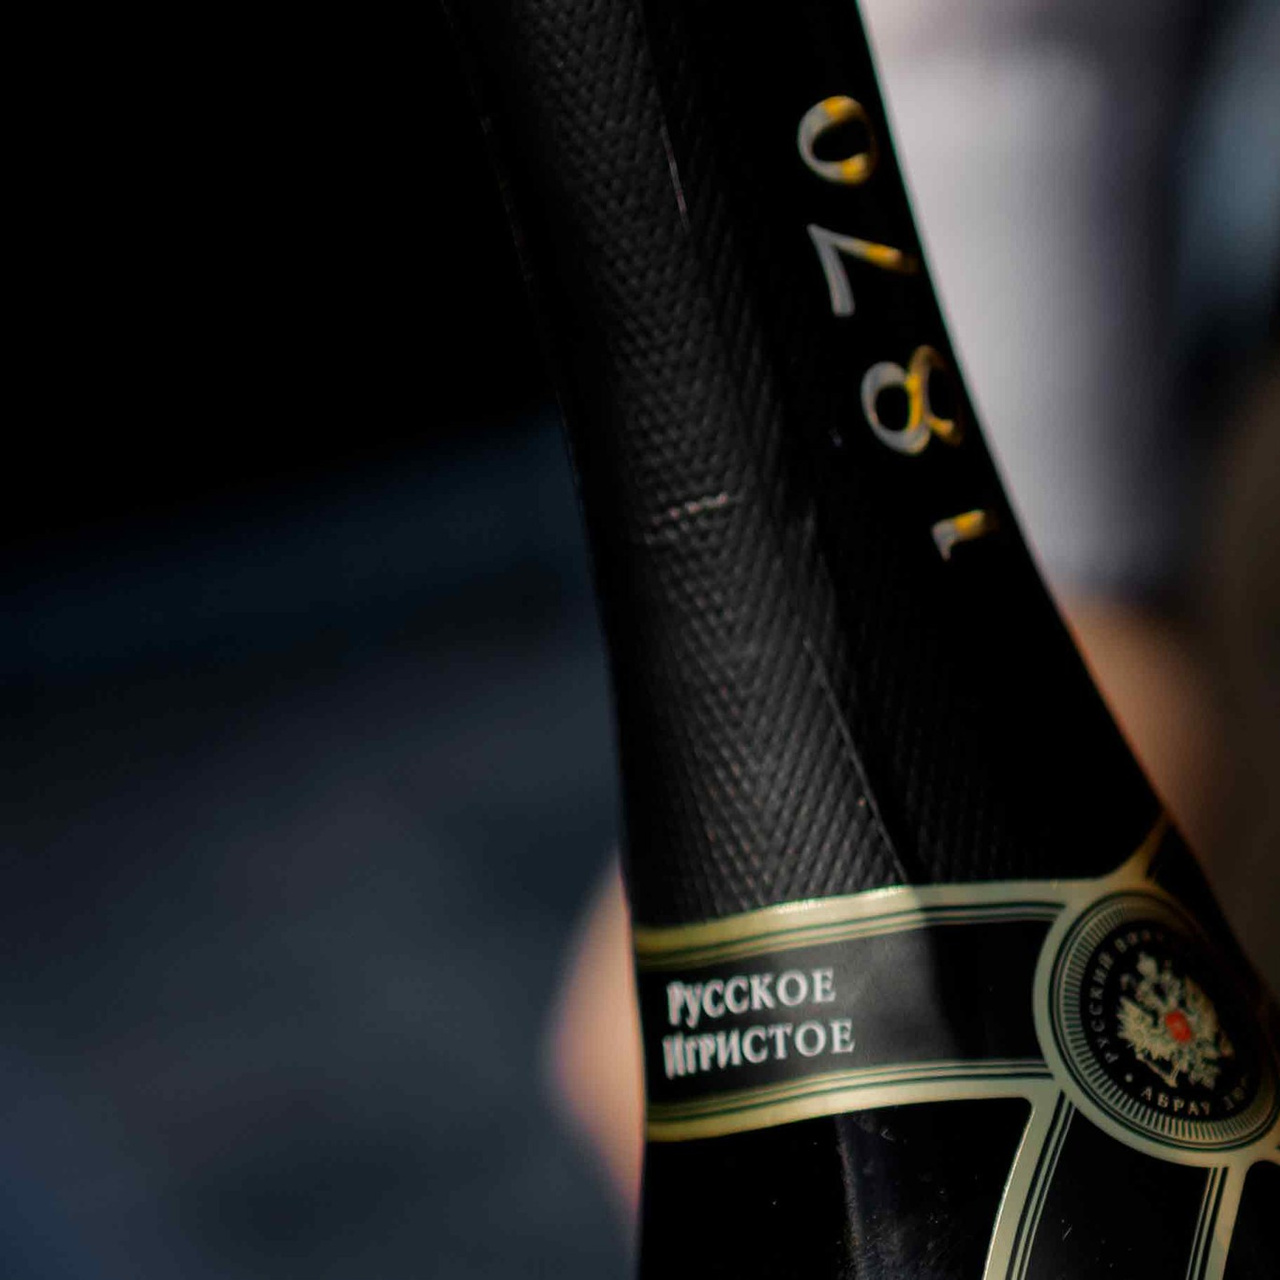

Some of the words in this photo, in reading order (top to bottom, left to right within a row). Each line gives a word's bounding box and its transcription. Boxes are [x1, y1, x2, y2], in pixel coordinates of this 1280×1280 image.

[797, 94, 1000, 565] 1870
[666, 967, 836, 1030] РУССКОЕ
[661, 1018, 856, 1080] ИГРИСТОЕ
